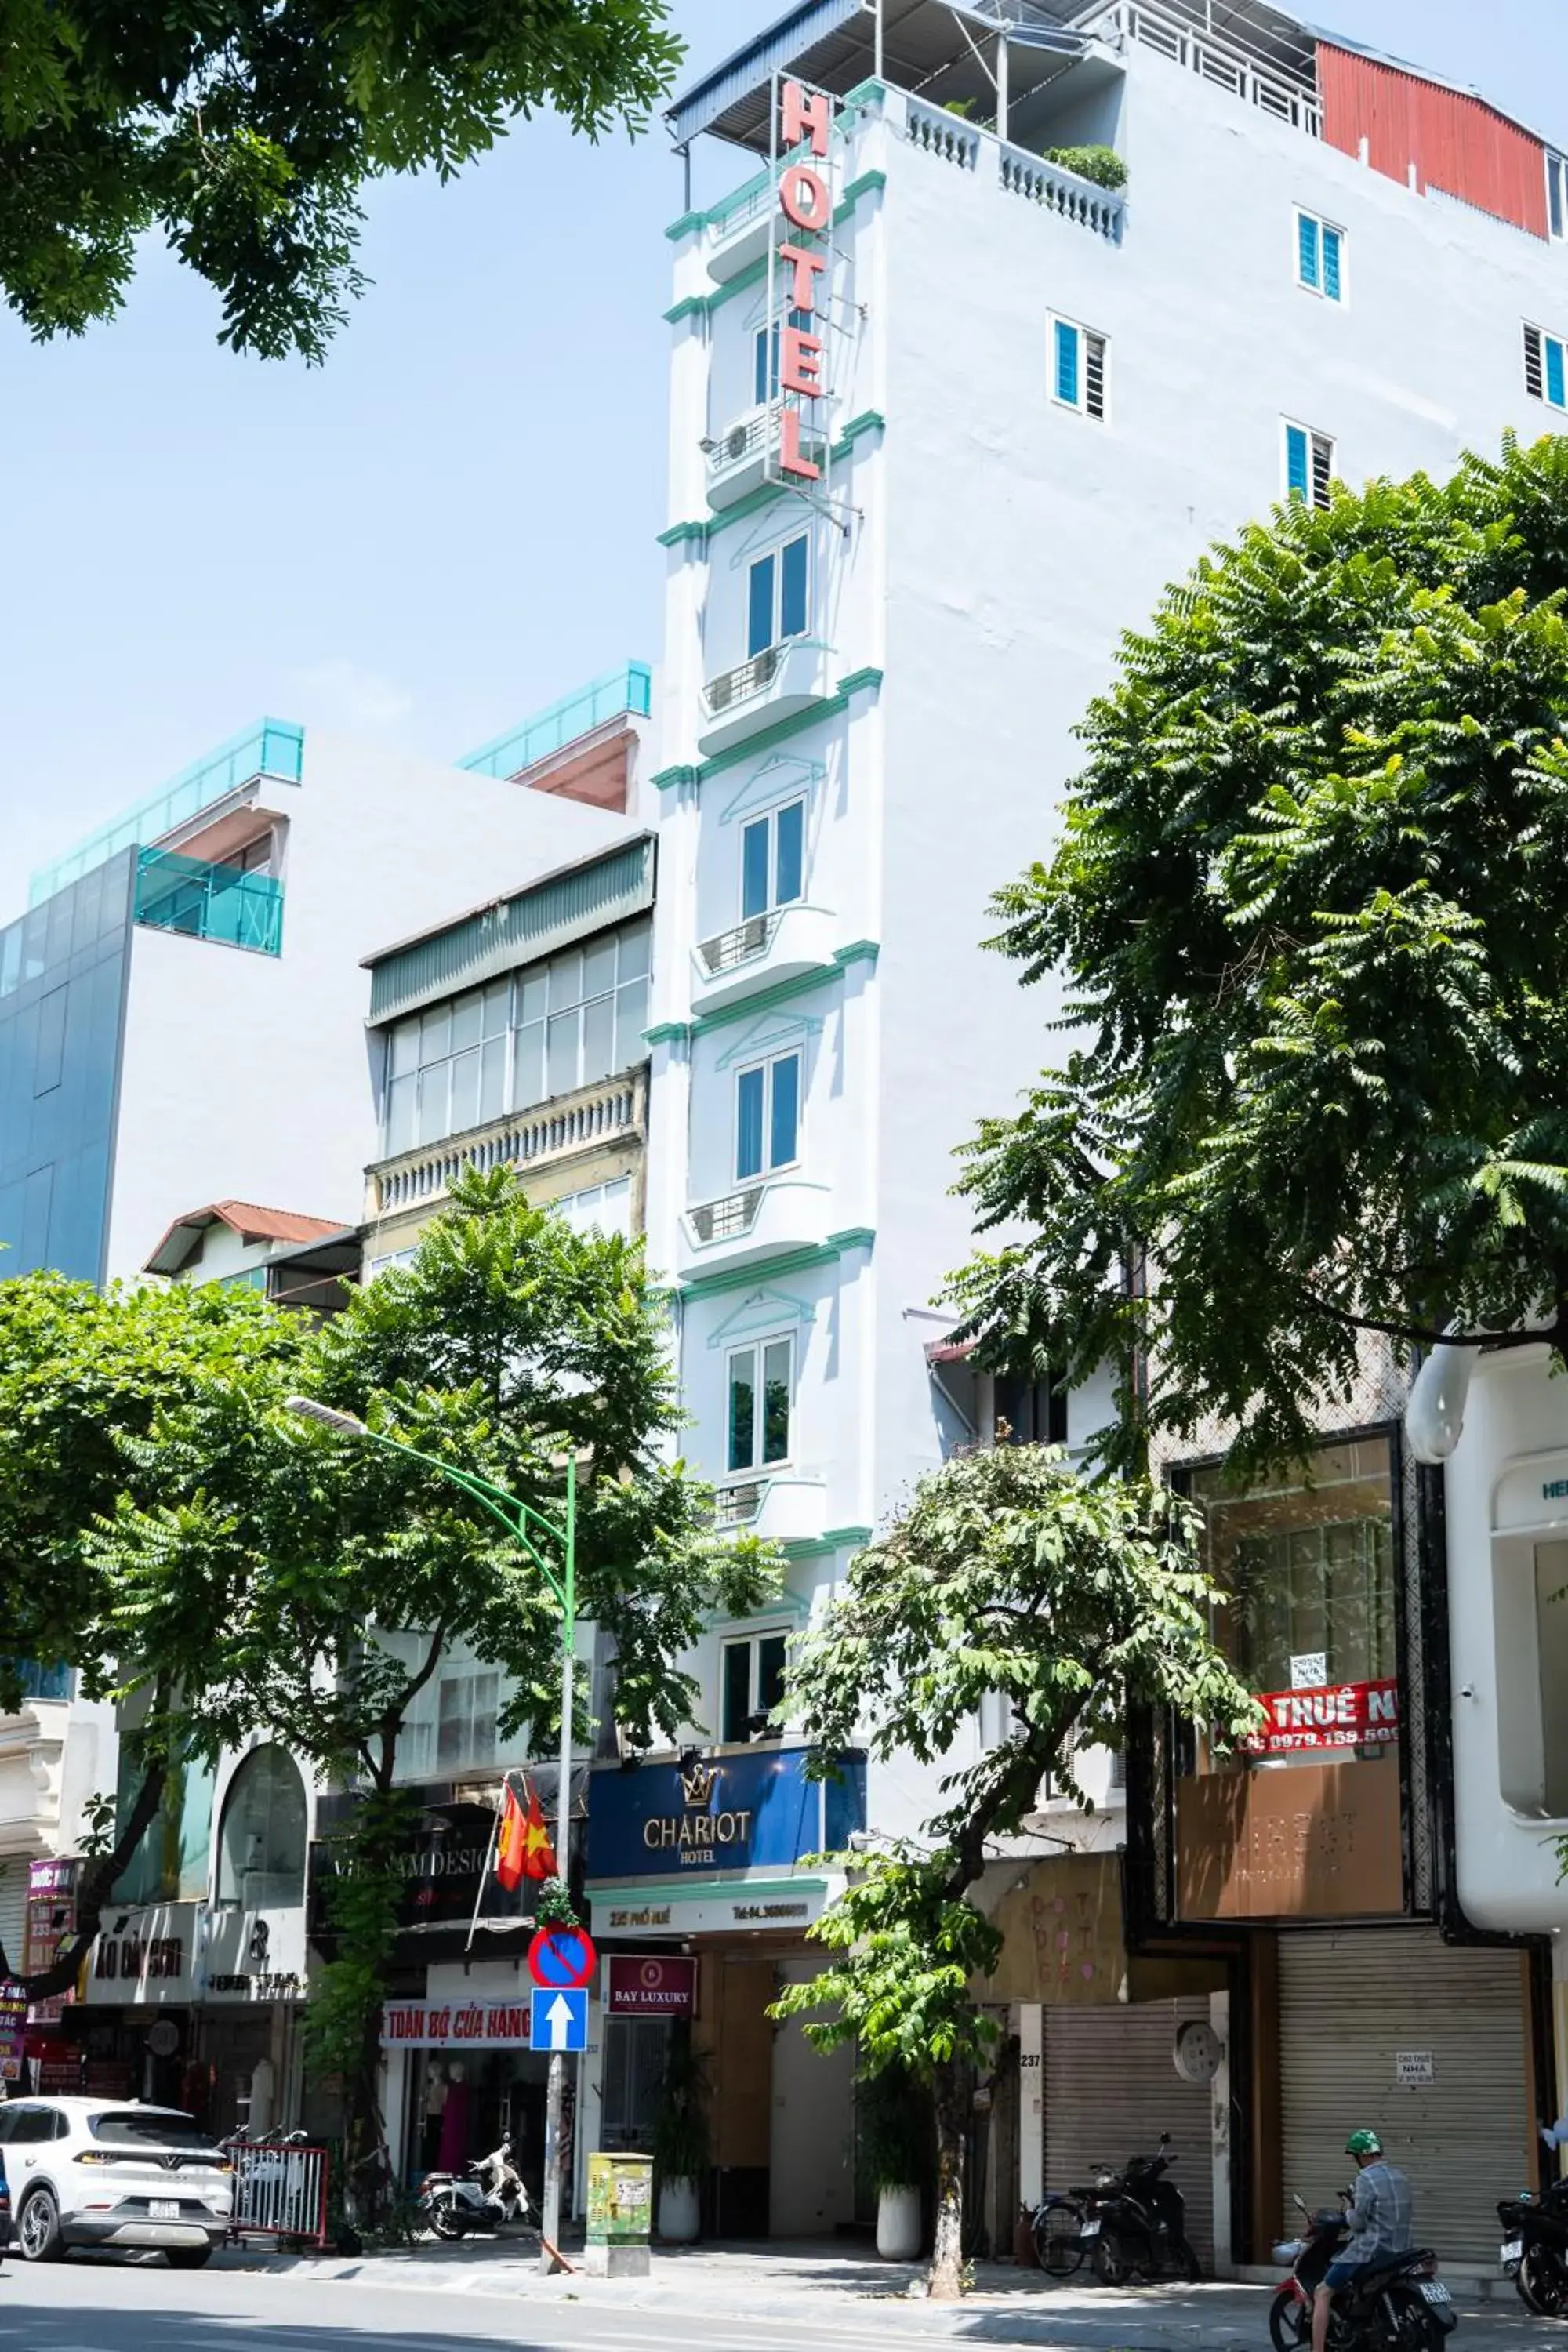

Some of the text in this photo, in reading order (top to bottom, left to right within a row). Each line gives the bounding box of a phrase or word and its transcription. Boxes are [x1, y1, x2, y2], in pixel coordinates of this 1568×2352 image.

[780, 80, 829, 481] HOTEL
[1272, 1687, 1398, 1728] THUÊ N
[644, 1812, 750, 1848] CHARIOT
[681, 1849, 715, 1864] HOTEL
[95, 1933, 117, 1979] ÁO
[615, 1991, 689, 2003] BAY LUXURY
[389, 2005, 424, 2038] TOÀN
[488, 2004, 530, 2038] HÀNG
[1022, 2055, 1040, 2067] 237
